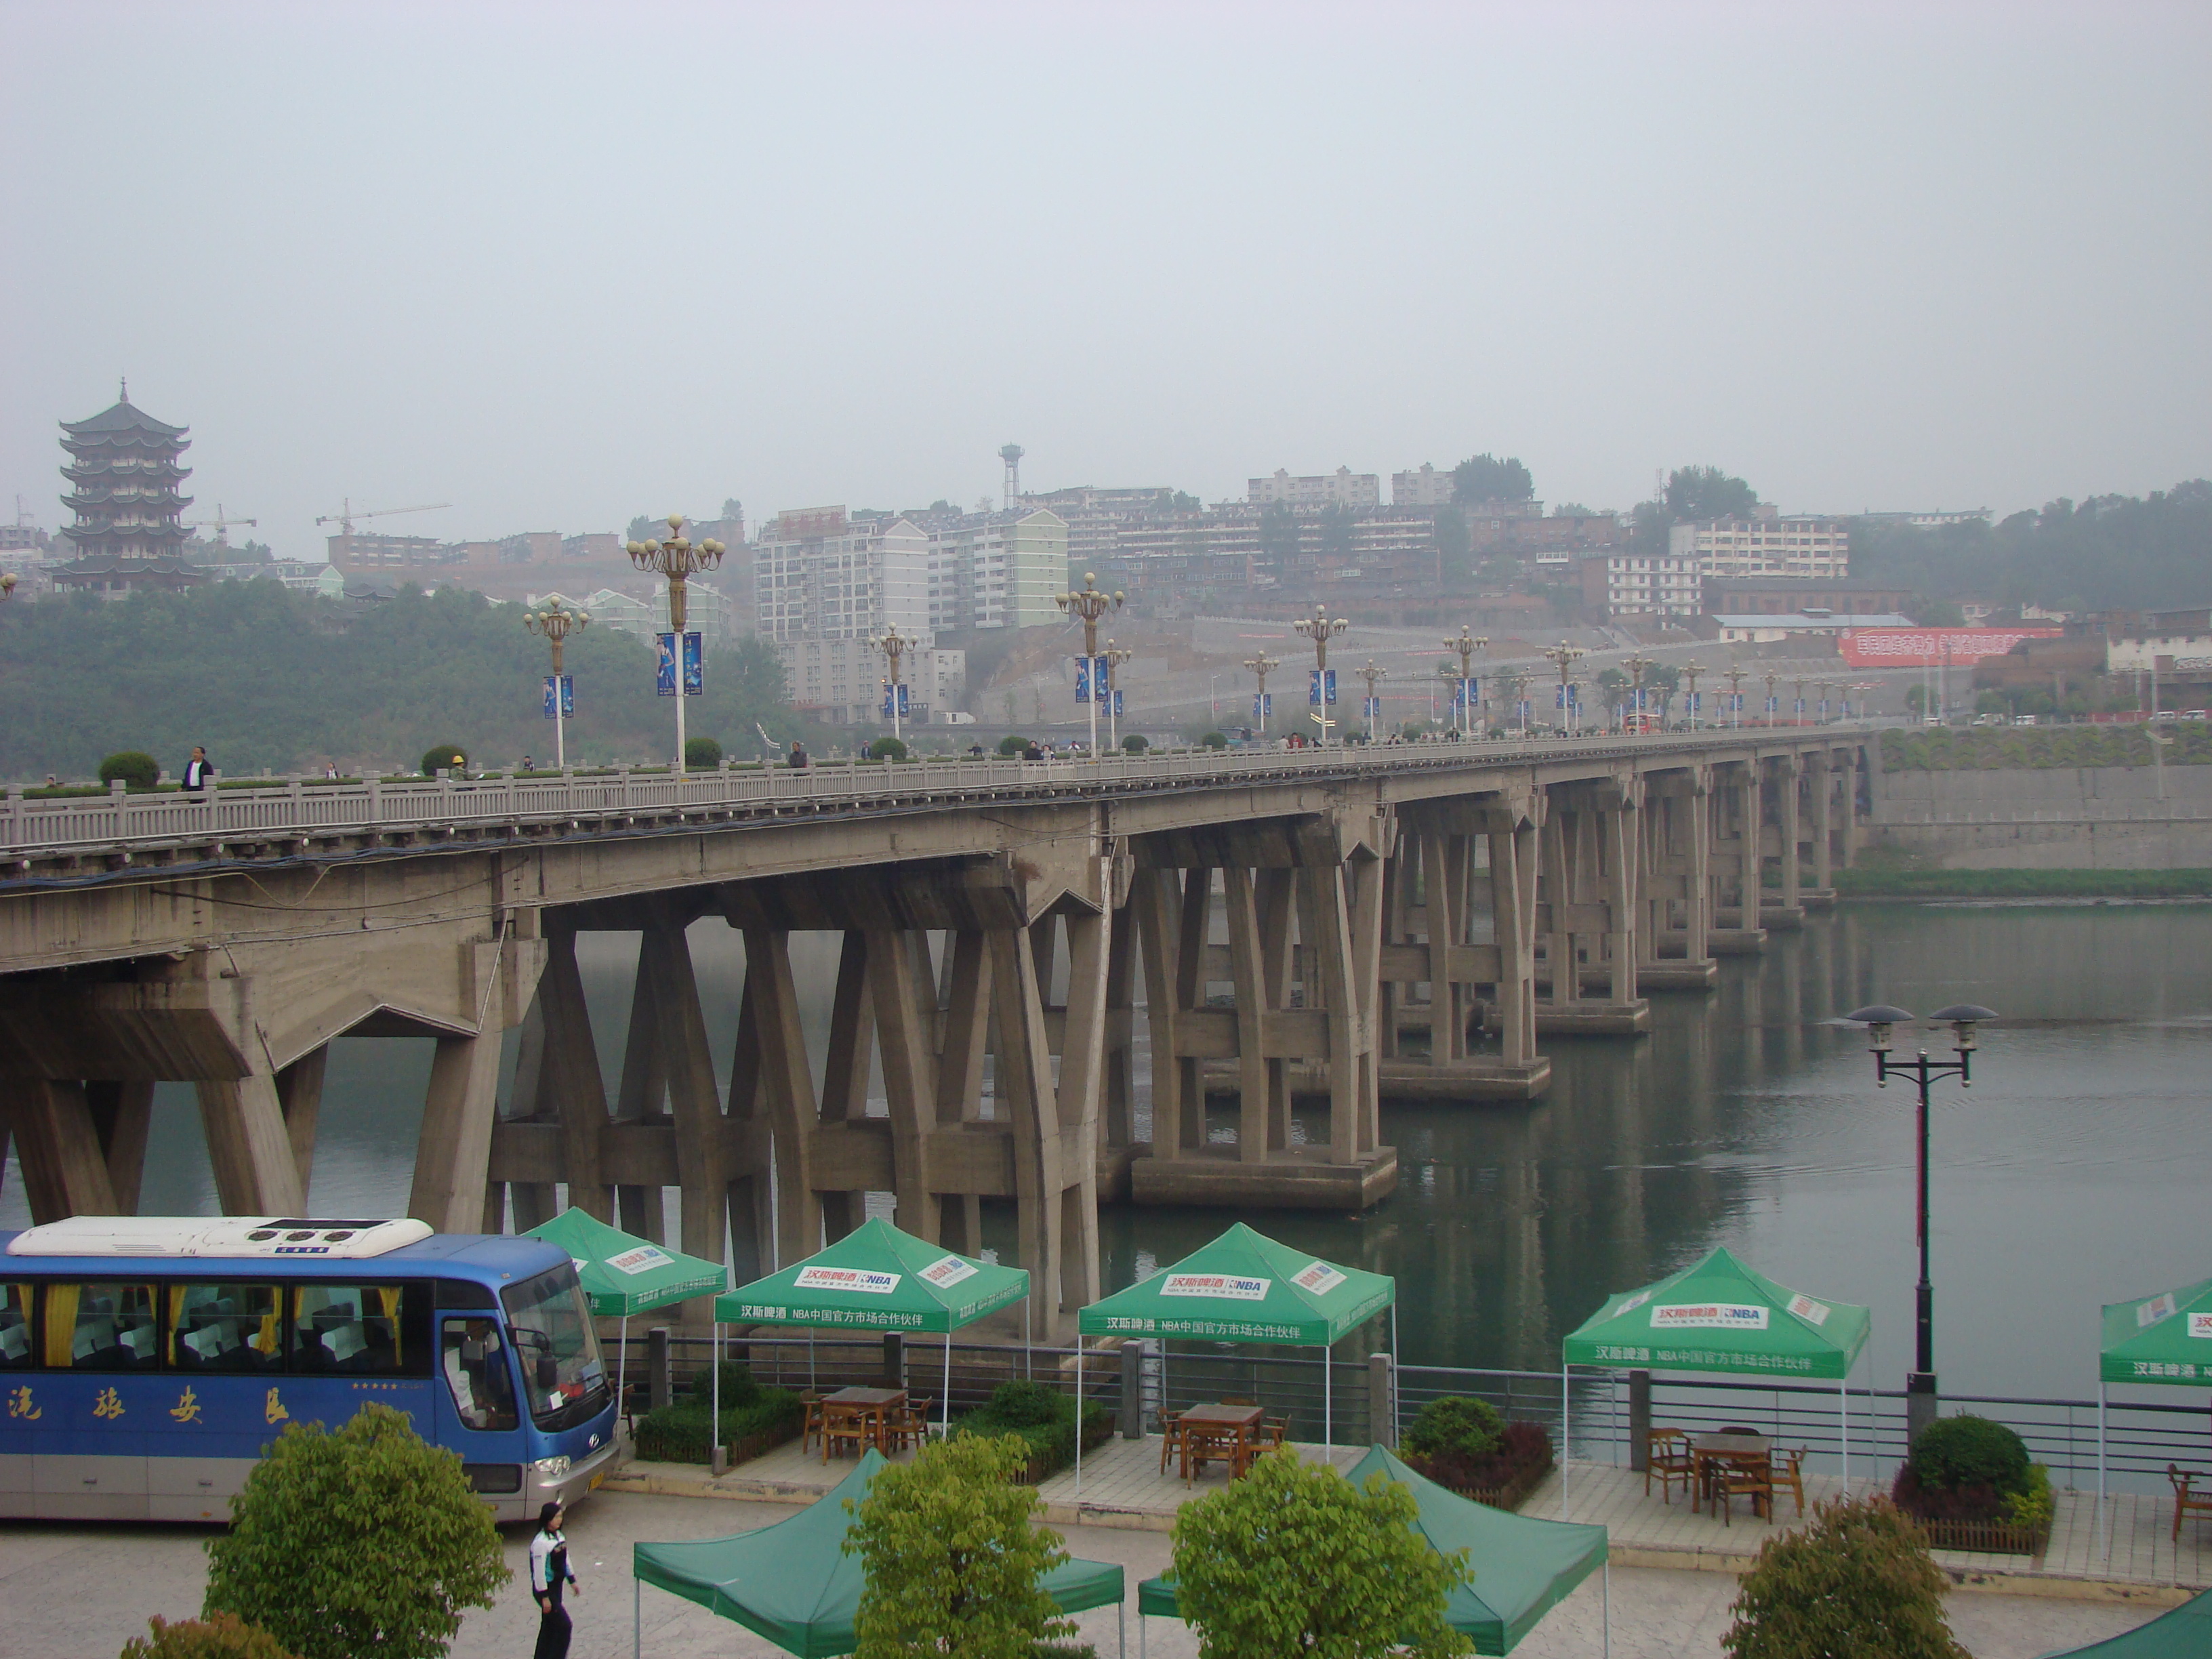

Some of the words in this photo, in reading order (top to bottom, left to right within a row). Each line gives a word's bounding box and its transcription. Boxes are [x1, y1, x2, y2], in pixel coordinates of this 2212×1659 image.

[804, 1269, 857, 1282] 汉斯啤酒
[867, 1275, 891, 1285] NBA
[1169, 1277, 1225, 1288] 汉斯啤酒
[1236, 1280, 1261, 1291] NBA
[741, 1305, 786, 1319] 汉斯啤酒
[1732, 1309, 1759, 1319] NBA
[1107, 1317, 1155, 1331] 汉斯啤酒
[1595, 1345, 1650, 1361] 汉斯啤酒
[2134, 1362, 2196, 1378] 汉斯啤酒
